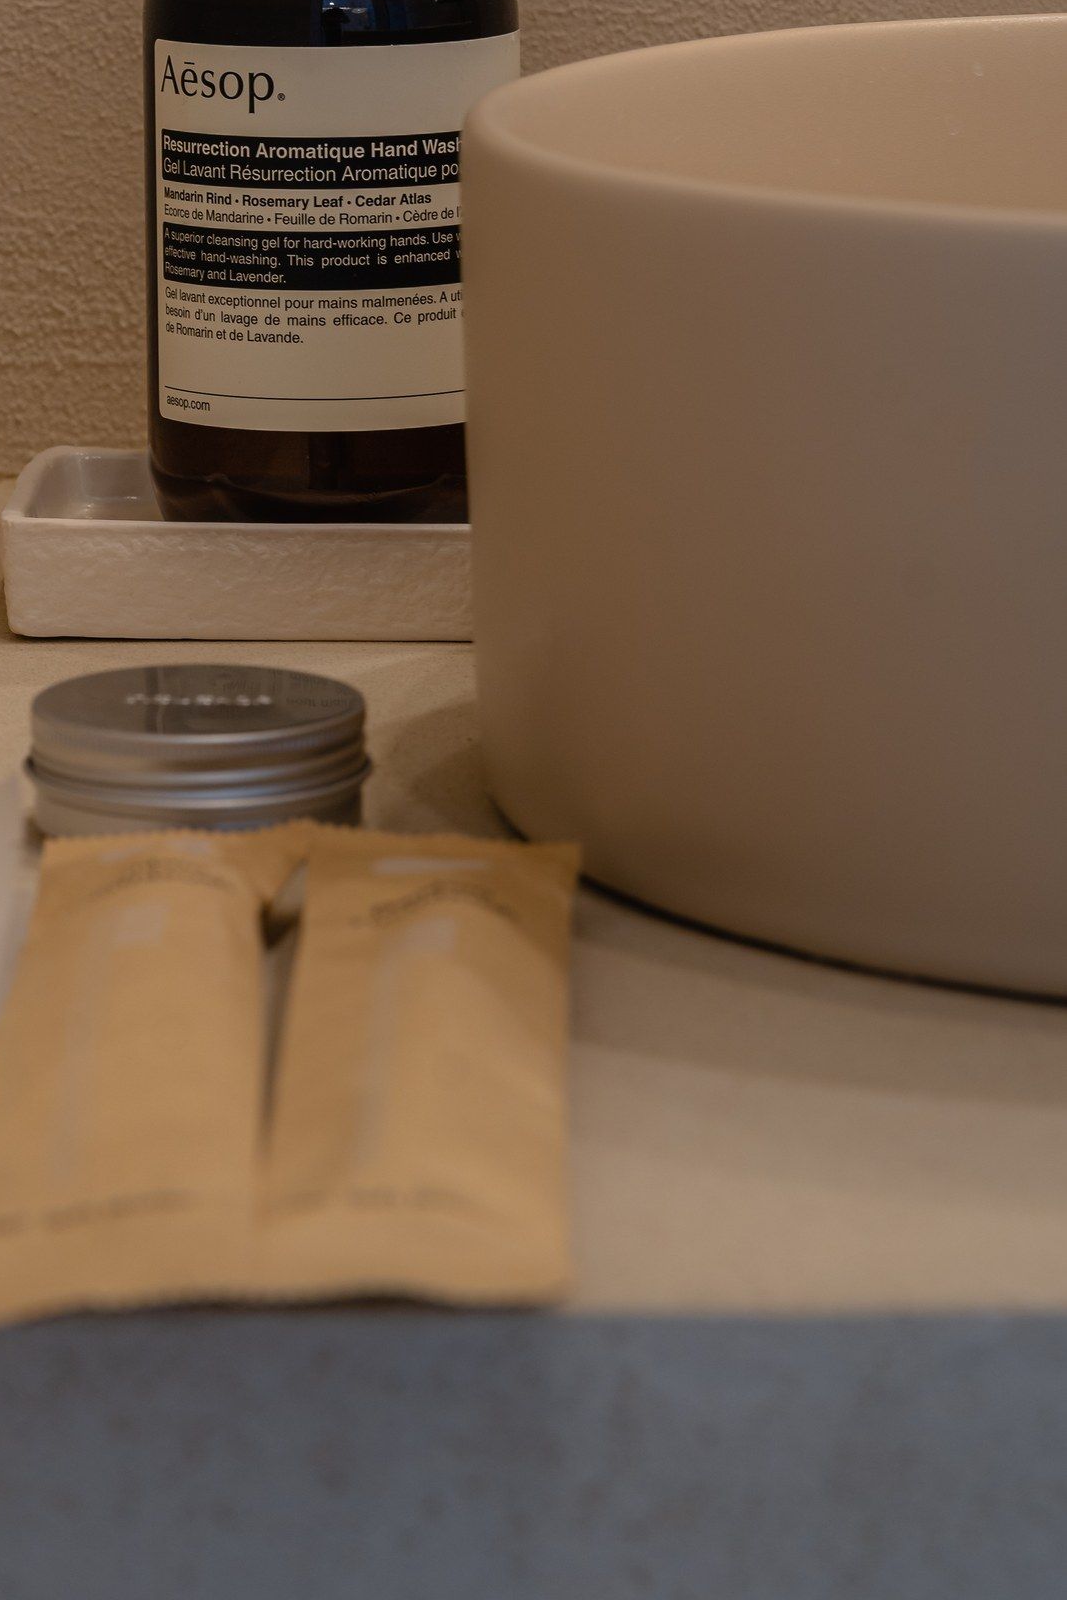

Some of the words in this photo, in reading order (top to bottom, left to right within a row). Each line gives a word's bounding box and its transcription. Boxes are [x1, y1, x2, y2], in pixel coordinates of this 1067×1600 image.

[163, 135, 250, 158] Resurrection
[255, 142, 365, 163] Aromatique
[371, 140, 418, 158] Hand
[163, 157, 180, 175] Gel
[183, 160, 226, 179] Lavant
[230, 163, 336, 182] Résurrection
[341, 163, 437, 182] Aromatique
[164, 186, 203, 203] Mandarin
[206, 191, 232, 205] Rind
[242, 194, 310, 210] Rosemary
[313, 195, 344, 207] Leaf
[355, 194, 397, 207] Cedar
[399, 192, 432, 205] Atlas
[191, 207, 204, 220] de
[206, 209, 264, 224] Mandarine
[274, 212, 316, 225] Feuille
[319, 213, 336, 225] de
[339, 211, 393, 225] Romarin
[402, 208, 438, 223] Cèdre
[440, 207, 454, 220] de
[164, 227, 170, 239] A
[170, 229, 205, 244] superior
[206, 233, 259, 251] cleansing
[261, 236, 280, 251] gel
[283, 236, 301, 249] for
[303, 235, 387, 251] hard-working
[390, 233, 430, 247] hands.
[431, 231, 454, 244] Use
[165, 244, 196, 260] effective
[200, 249, 282, 269] hand-washing.
[286, 254, 314, 267] This
[321, 254, 370, 269] product
[377, 252, 388, 265] is
[394, 248, 451, 264] enhanced
[165, 261, 205, 281] Rosemary
[206, 268, 227, 280] and
[229, 268, 287, 284] Lavender.
[165, 286, 178, 299] Gel
[179, 288, 206, 304] lavant
[208, 294, 281, 309] exceptionnel
[284, 298, 315, 311] pour
[318, 296, 358, 309] mains
[362, 292, 437, 308] malmenées.
[165, 303, 191, 319] besoin
[194, 308, 216, 322] d'un
[220, 310, 258, 327] lavage
[264, 313, 280, 326] de
[287, 313, 326, 327] mains
[333, 312, 388, 326] efficace.
[393, 311, 412, 324] Ce
[417, 307, 457, 325] produit
[165, 321, 174, 333] de
[175, 322, 214, 339] Romarin
[216, 328, 227, 340] et
[229, 328, 244, 341] de
[247, 329, 304, 343] Lavande.
[166, 395, 210, 411] aesop.com
